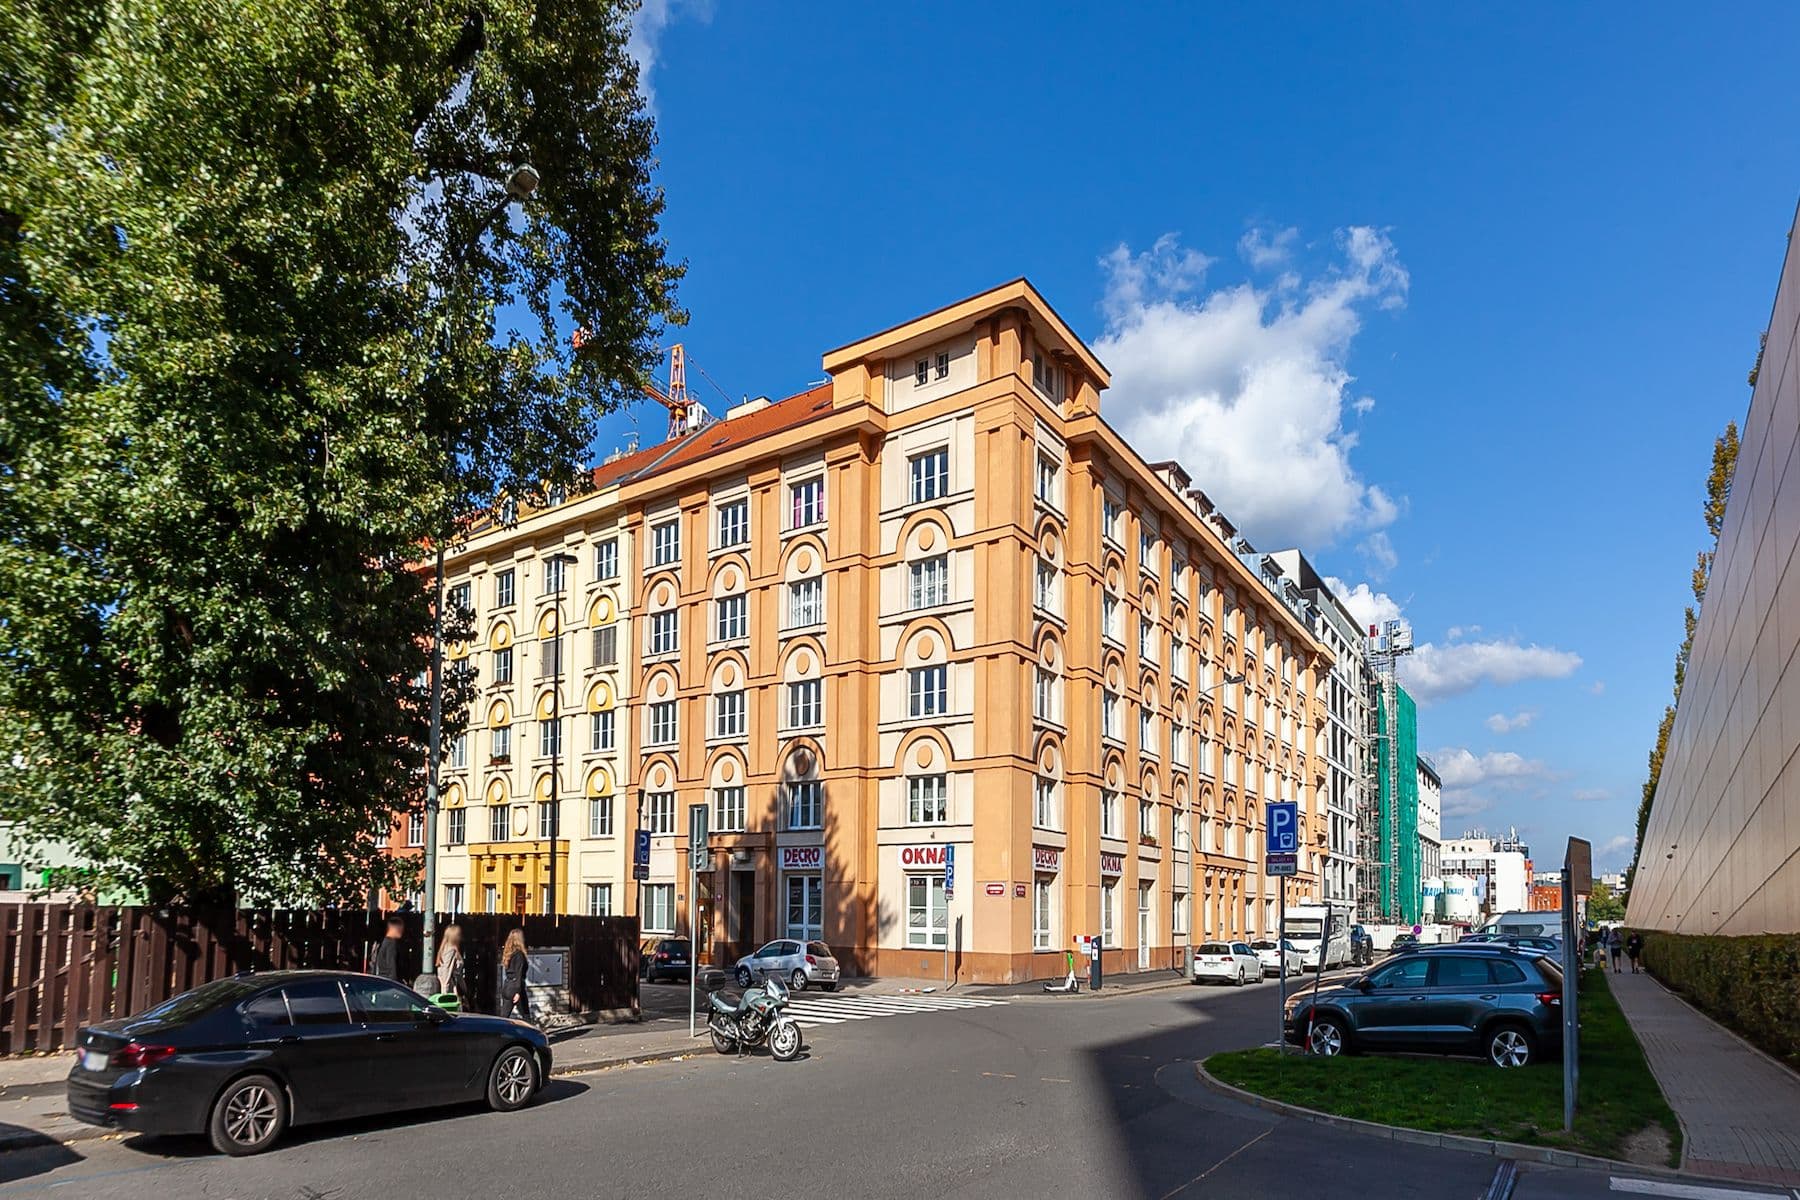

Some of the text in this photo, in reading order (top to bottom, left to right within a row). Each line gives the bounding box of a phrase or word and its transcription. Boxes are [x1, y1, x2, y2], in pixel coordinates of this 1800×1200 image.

[1273, 809, 1290, 837] P
[784, 848, 820, 864] DECRO
[1036, 848, 1057, 865] DECRO
[1101, 855, 1121, 872] OKNA
[947, 866, 953, 880] P
